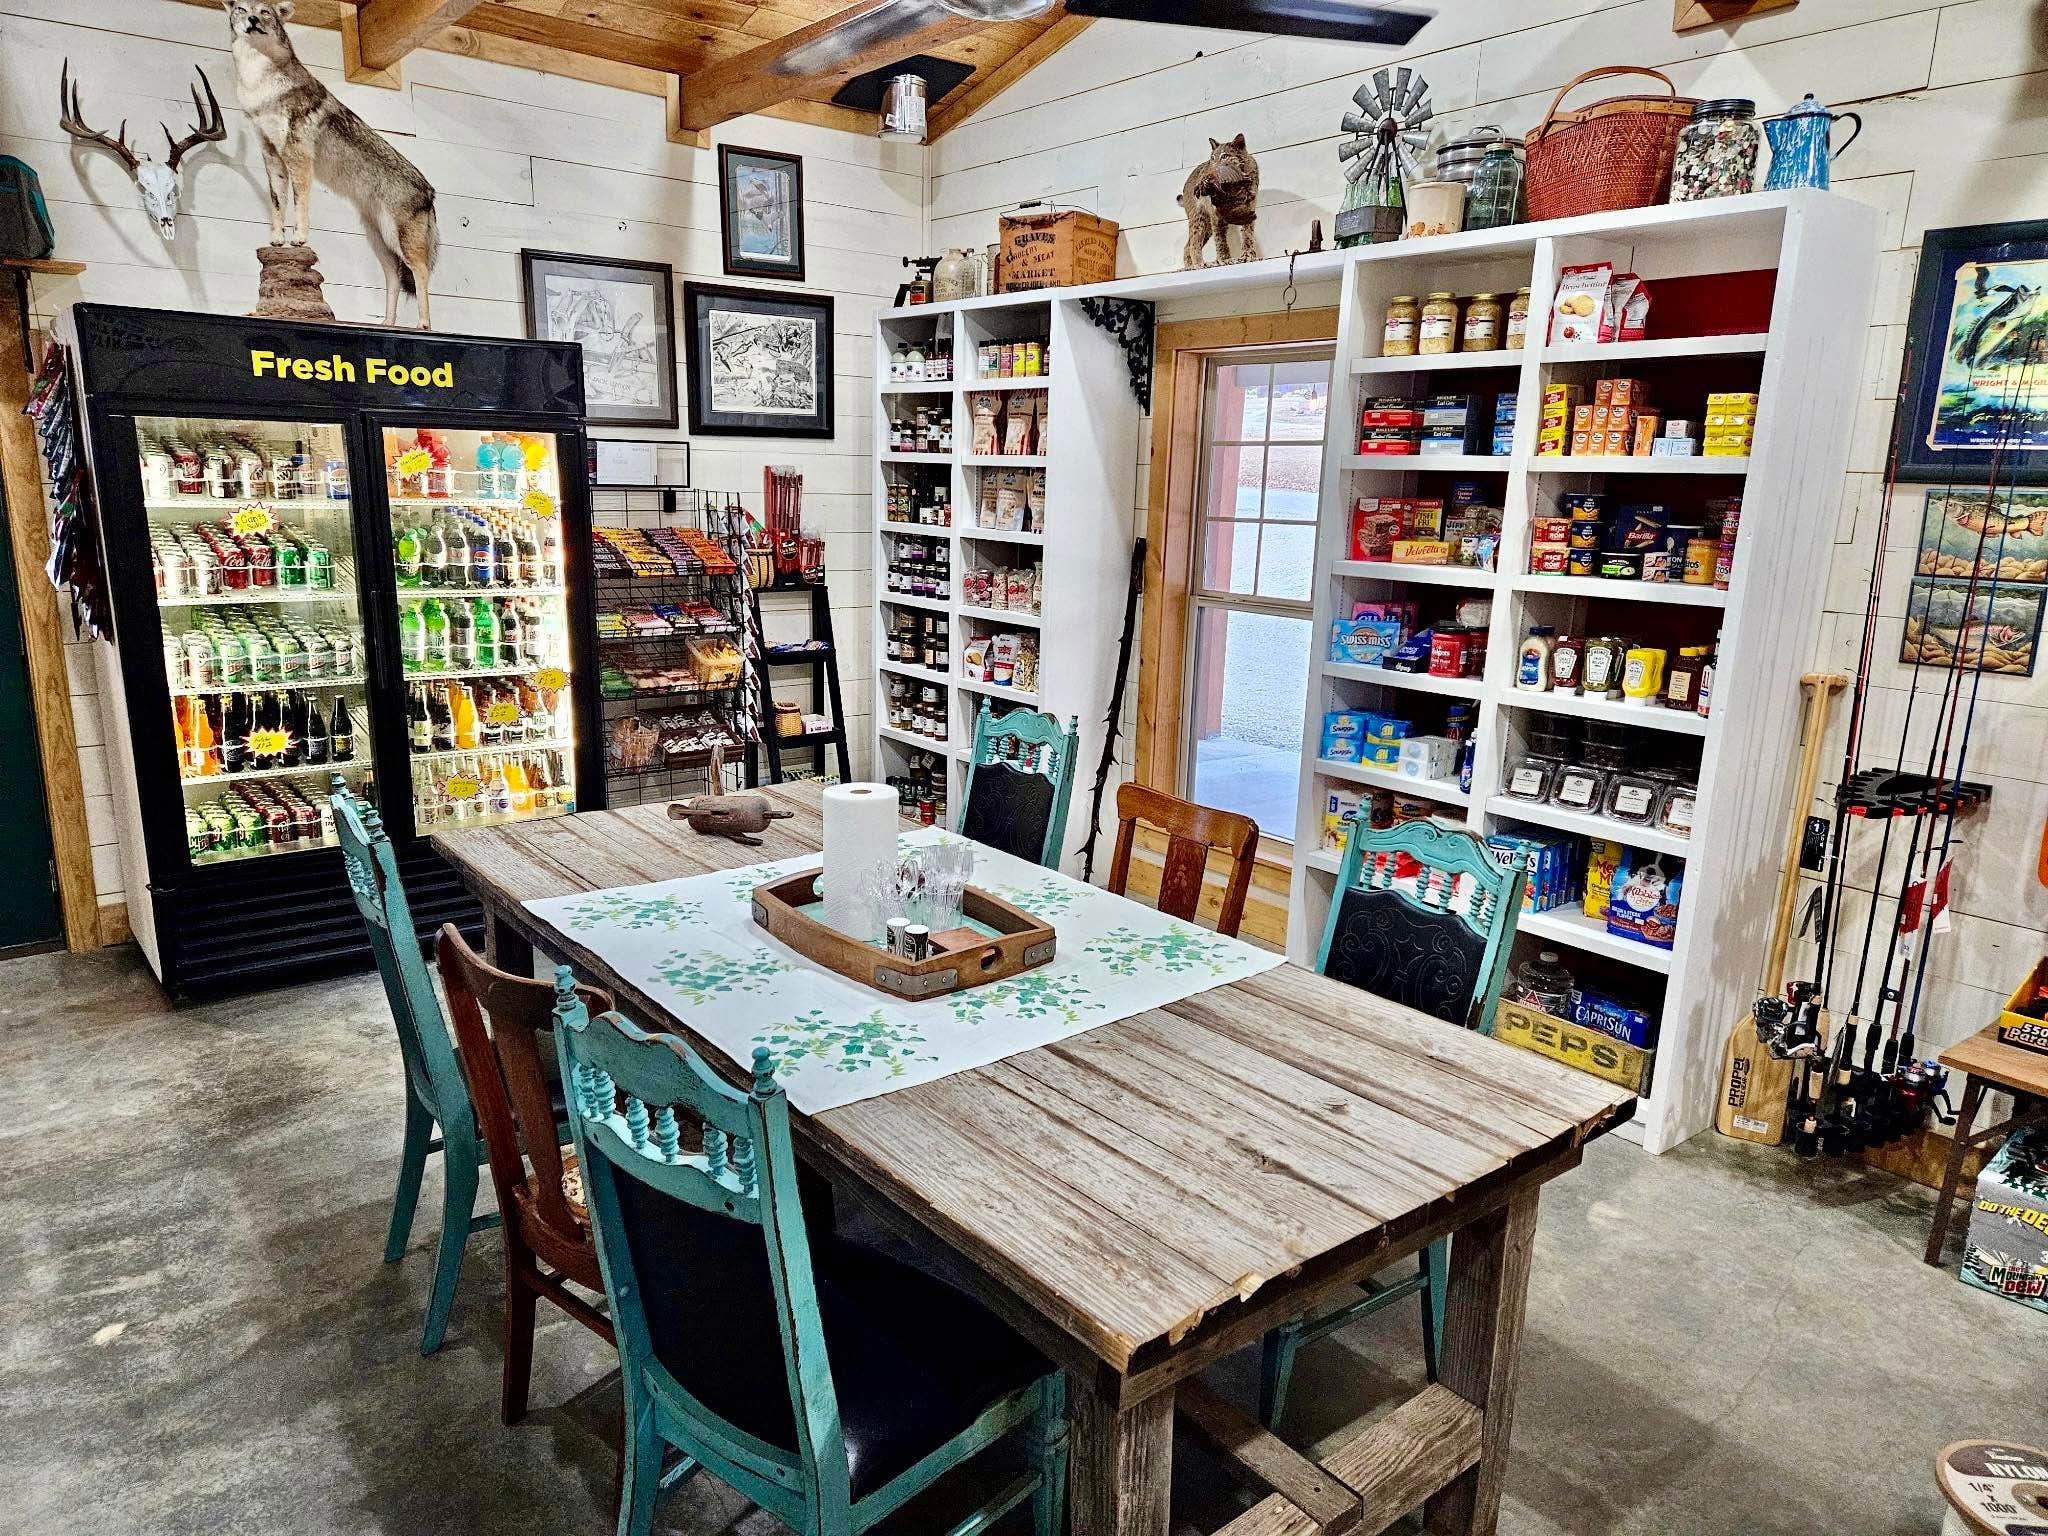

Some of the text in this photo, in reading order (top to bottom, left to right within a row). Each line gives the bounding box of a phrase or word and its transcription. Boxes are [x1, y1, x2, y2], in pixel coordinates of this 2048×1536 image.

[251, 350, 454, 388] Fresh Food
[1972, 379, 2009, 387] WRIGHT
[1549, 532, 1565, 540] RONI
[1627, 532, 1656, 541] Barilla
[1340, 634, 1392, 649] SWISS MISS
[1575, 1005, 1632, 1042] CAPRISUN
[1728, 1056, 1745, 1107] PROPEL
[1979, 1200, 1999, 1213] DO
[2000, 1204, 2024, 1218] THE
